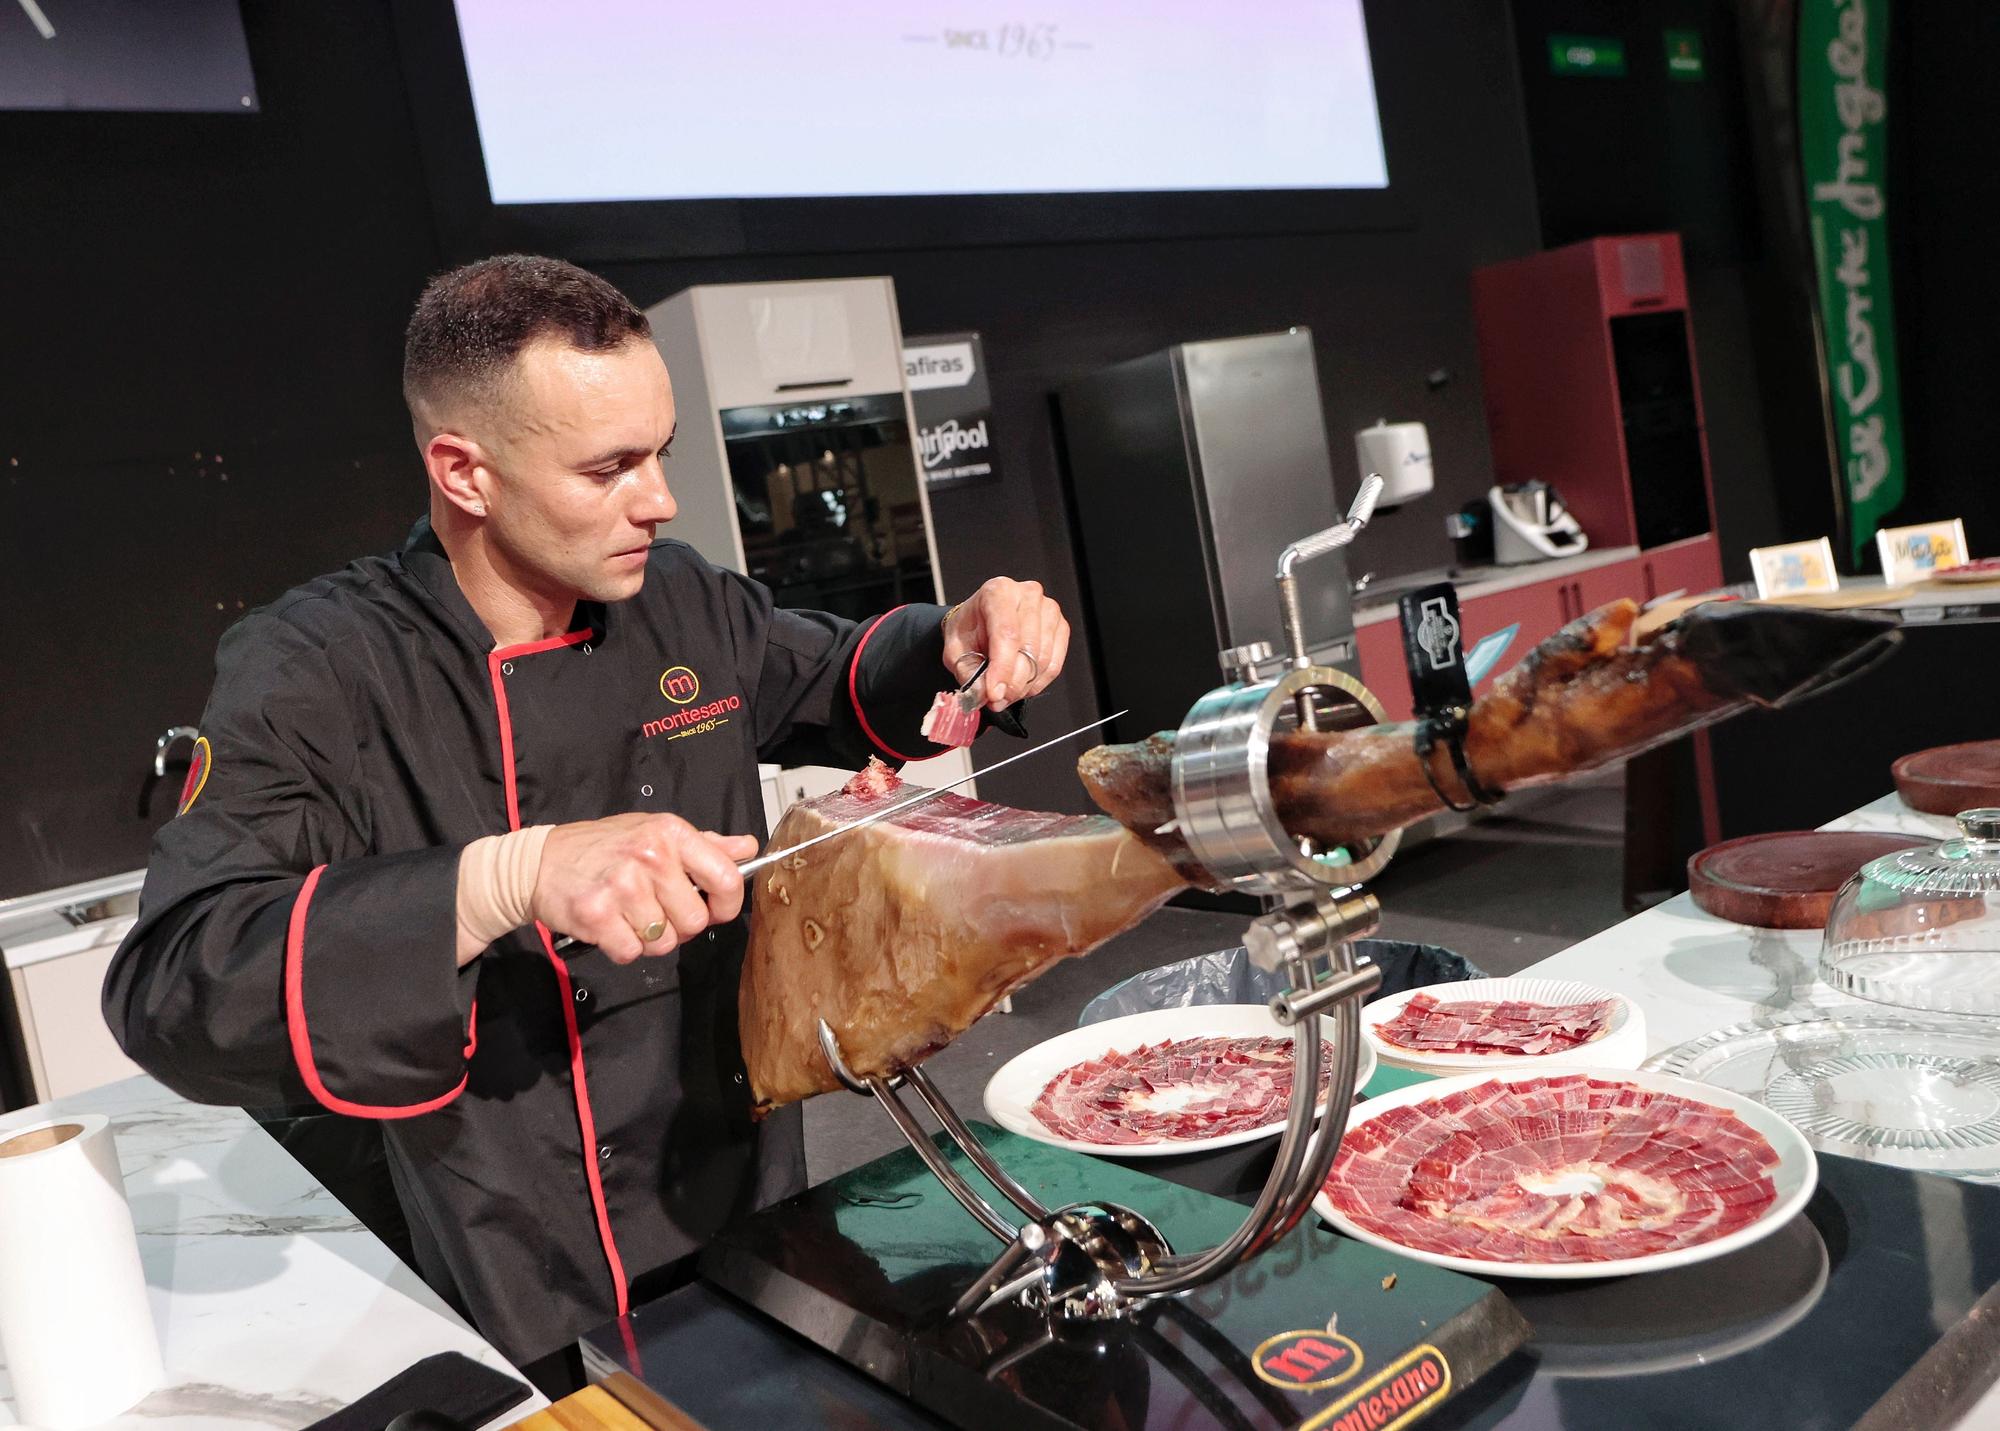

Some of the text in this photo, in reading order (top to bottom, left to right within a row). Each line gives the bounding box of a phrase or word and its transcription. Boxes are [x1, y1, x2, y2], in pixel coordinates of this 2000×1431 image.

[1814, 0, 1887, 221] Ingle
[1835, 226, 1881, 416] Corte
[666, 674, 694, 696] m
[642, 695, 740, 738] montesano
[696, 717, 716, 734] 1965
